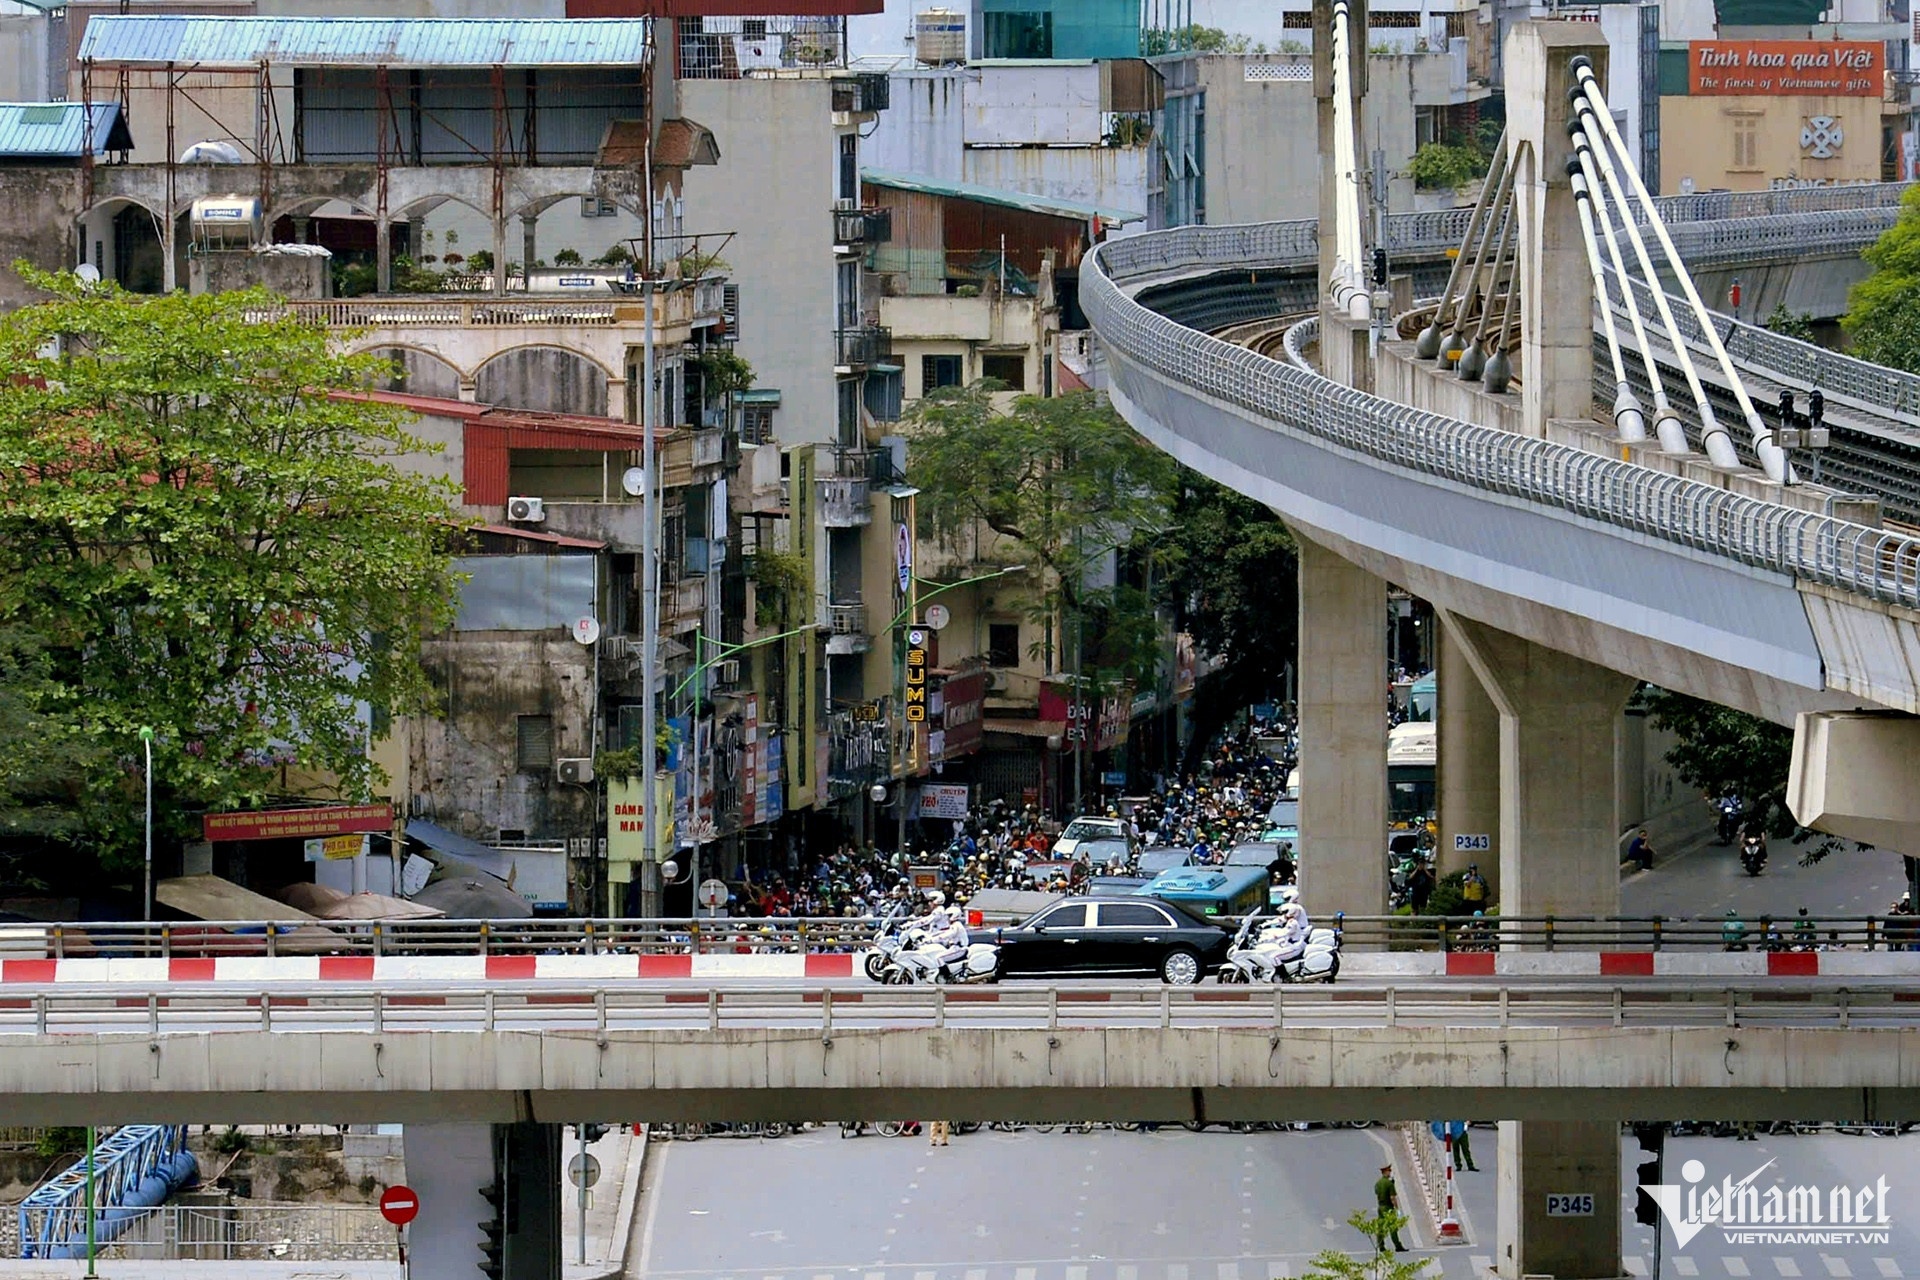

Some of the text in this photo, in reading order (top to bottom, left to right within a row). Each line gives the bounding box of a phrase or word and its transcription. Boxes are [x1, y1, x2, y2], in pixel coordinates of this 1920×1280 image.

[1700, 48, 1740, 67] Tinh
[1746, 49, 1785, 67] hoa
[1834, 48, 1874, 72] Việt
[1700, 77, 1872, 91] The finest of Vietnamese gifts
[907, 650, 925, 721] SUMO
[1456, 836, 1488, 849] P343
[1549, 1196, 1592, 1214] P345
